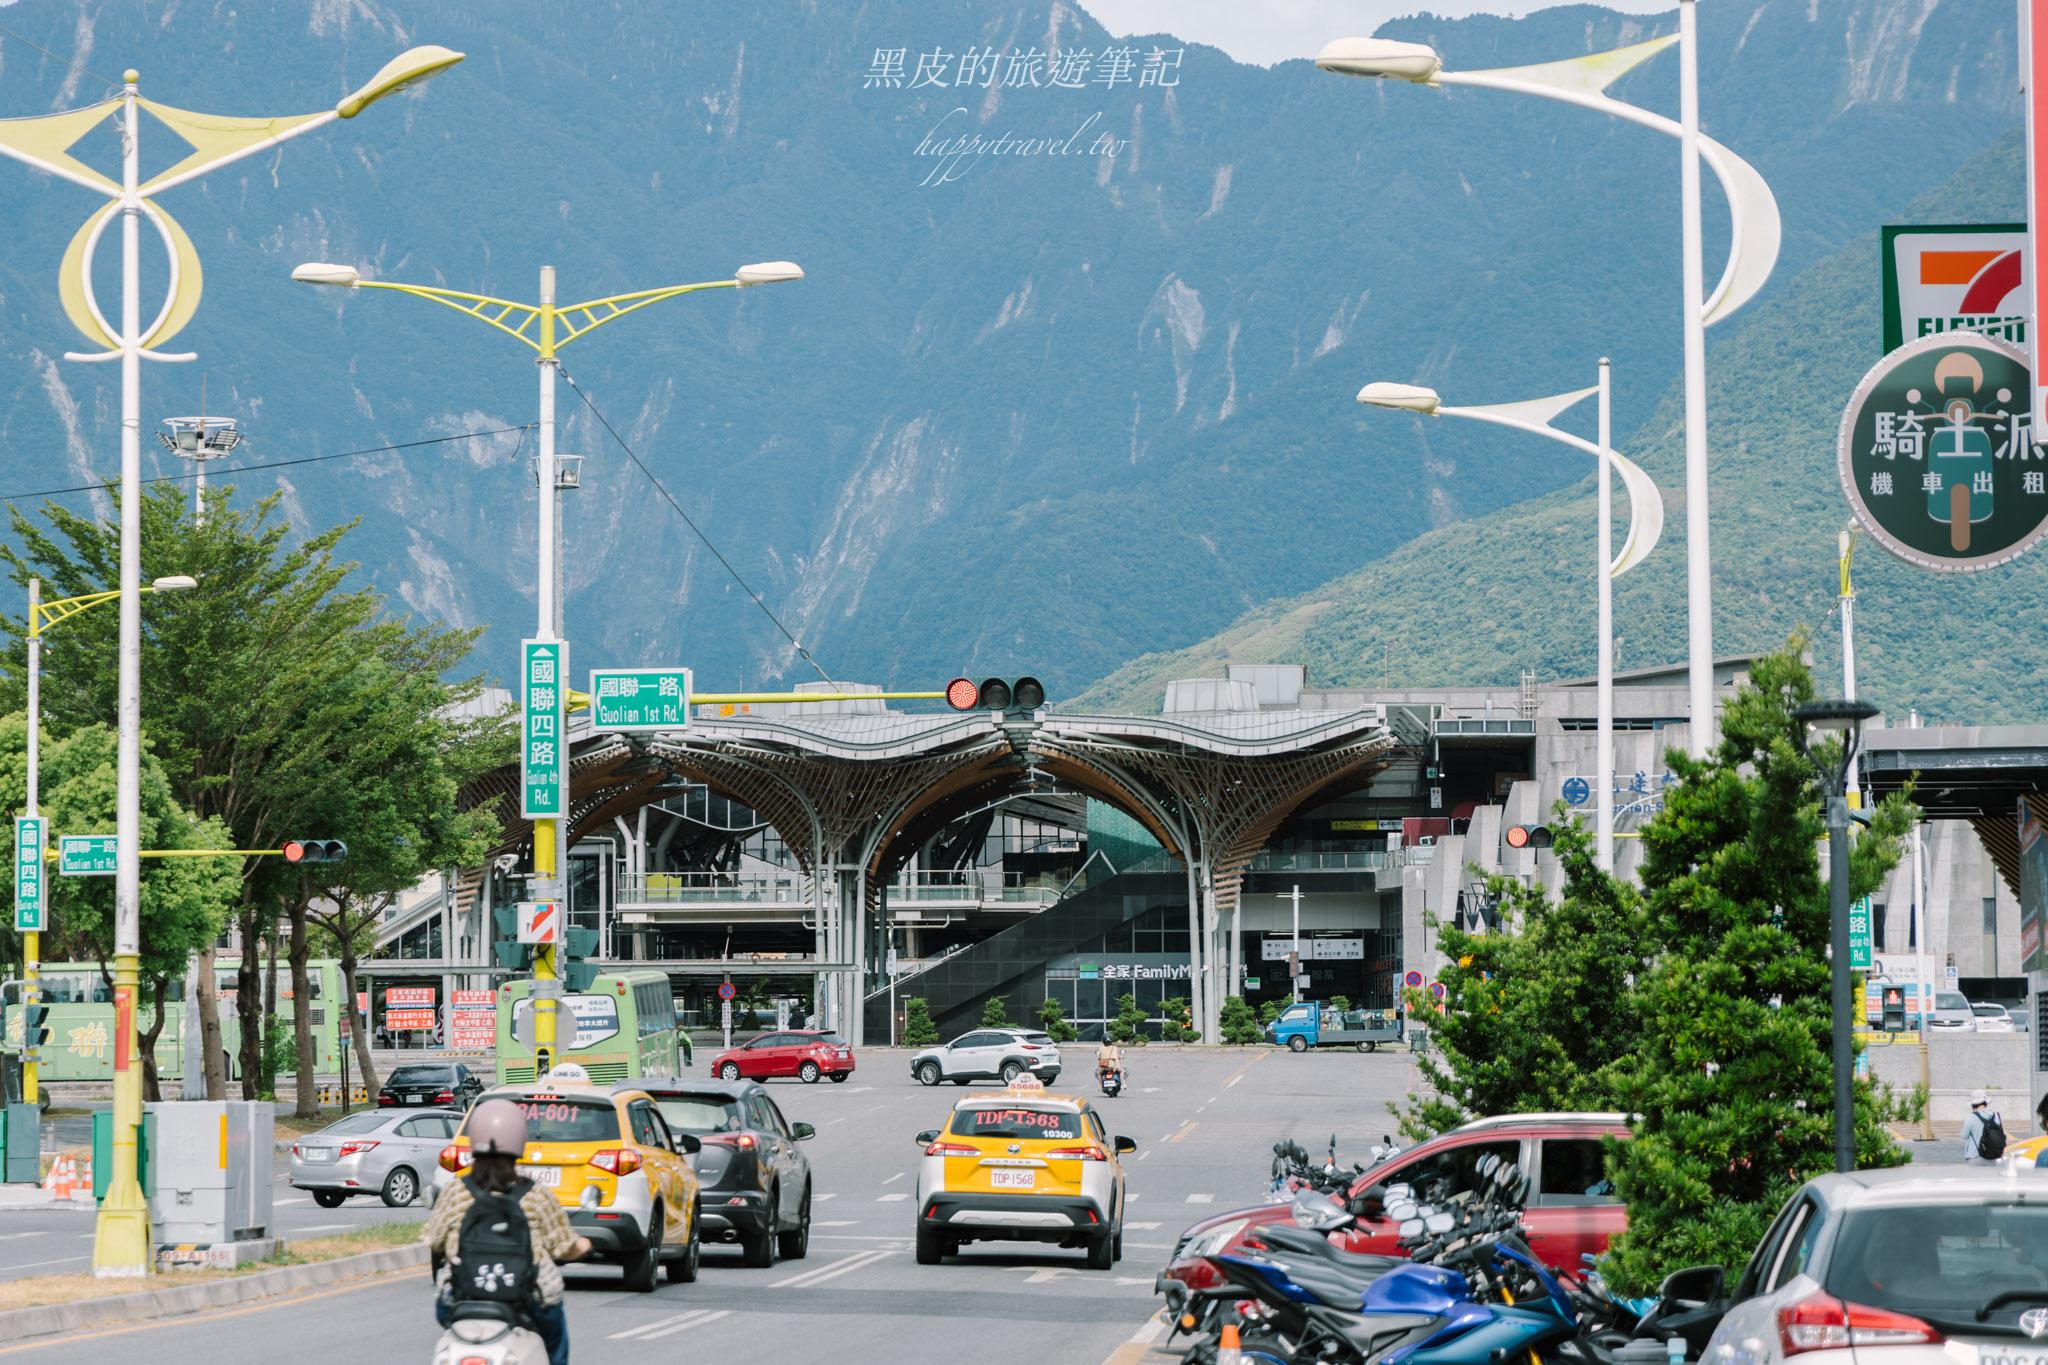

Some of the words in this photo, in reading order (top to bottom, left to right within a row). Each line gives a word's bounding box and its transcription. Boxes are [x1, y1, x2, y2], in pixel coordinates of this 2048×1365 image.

[1870, 409, 2046, 461] 騎士派
[1870, 470, 2046, 495] 機車出租
[600, 677, 680, 698] 國聯一路
[531, 660, 555, 765] 國聯四路
[600, 704, 639, 724] Guolian
[644, 704, 659, 722] 1st
[663, 703, 680, 722] Rd.
[534, 788, 551, 805] Rd.
[65, 840, 116, 853] 國聯一路
[21, 829, 38, 897] 國聯四路
[65, 858, 92, 870] Guolian
[23, 911, 34, 923] Rd.
[1853, 949, 1866, 962] Rd.
[1103, 964, 1131, 979] 全家
[1010, 1082, 1041, 1090] 55688
[976, 1111, 1060, 1128] TDP-1568
[1042, 1130, 1073, 1139] 10300
[992, 1172, 1034, 1185] TDP-1568
